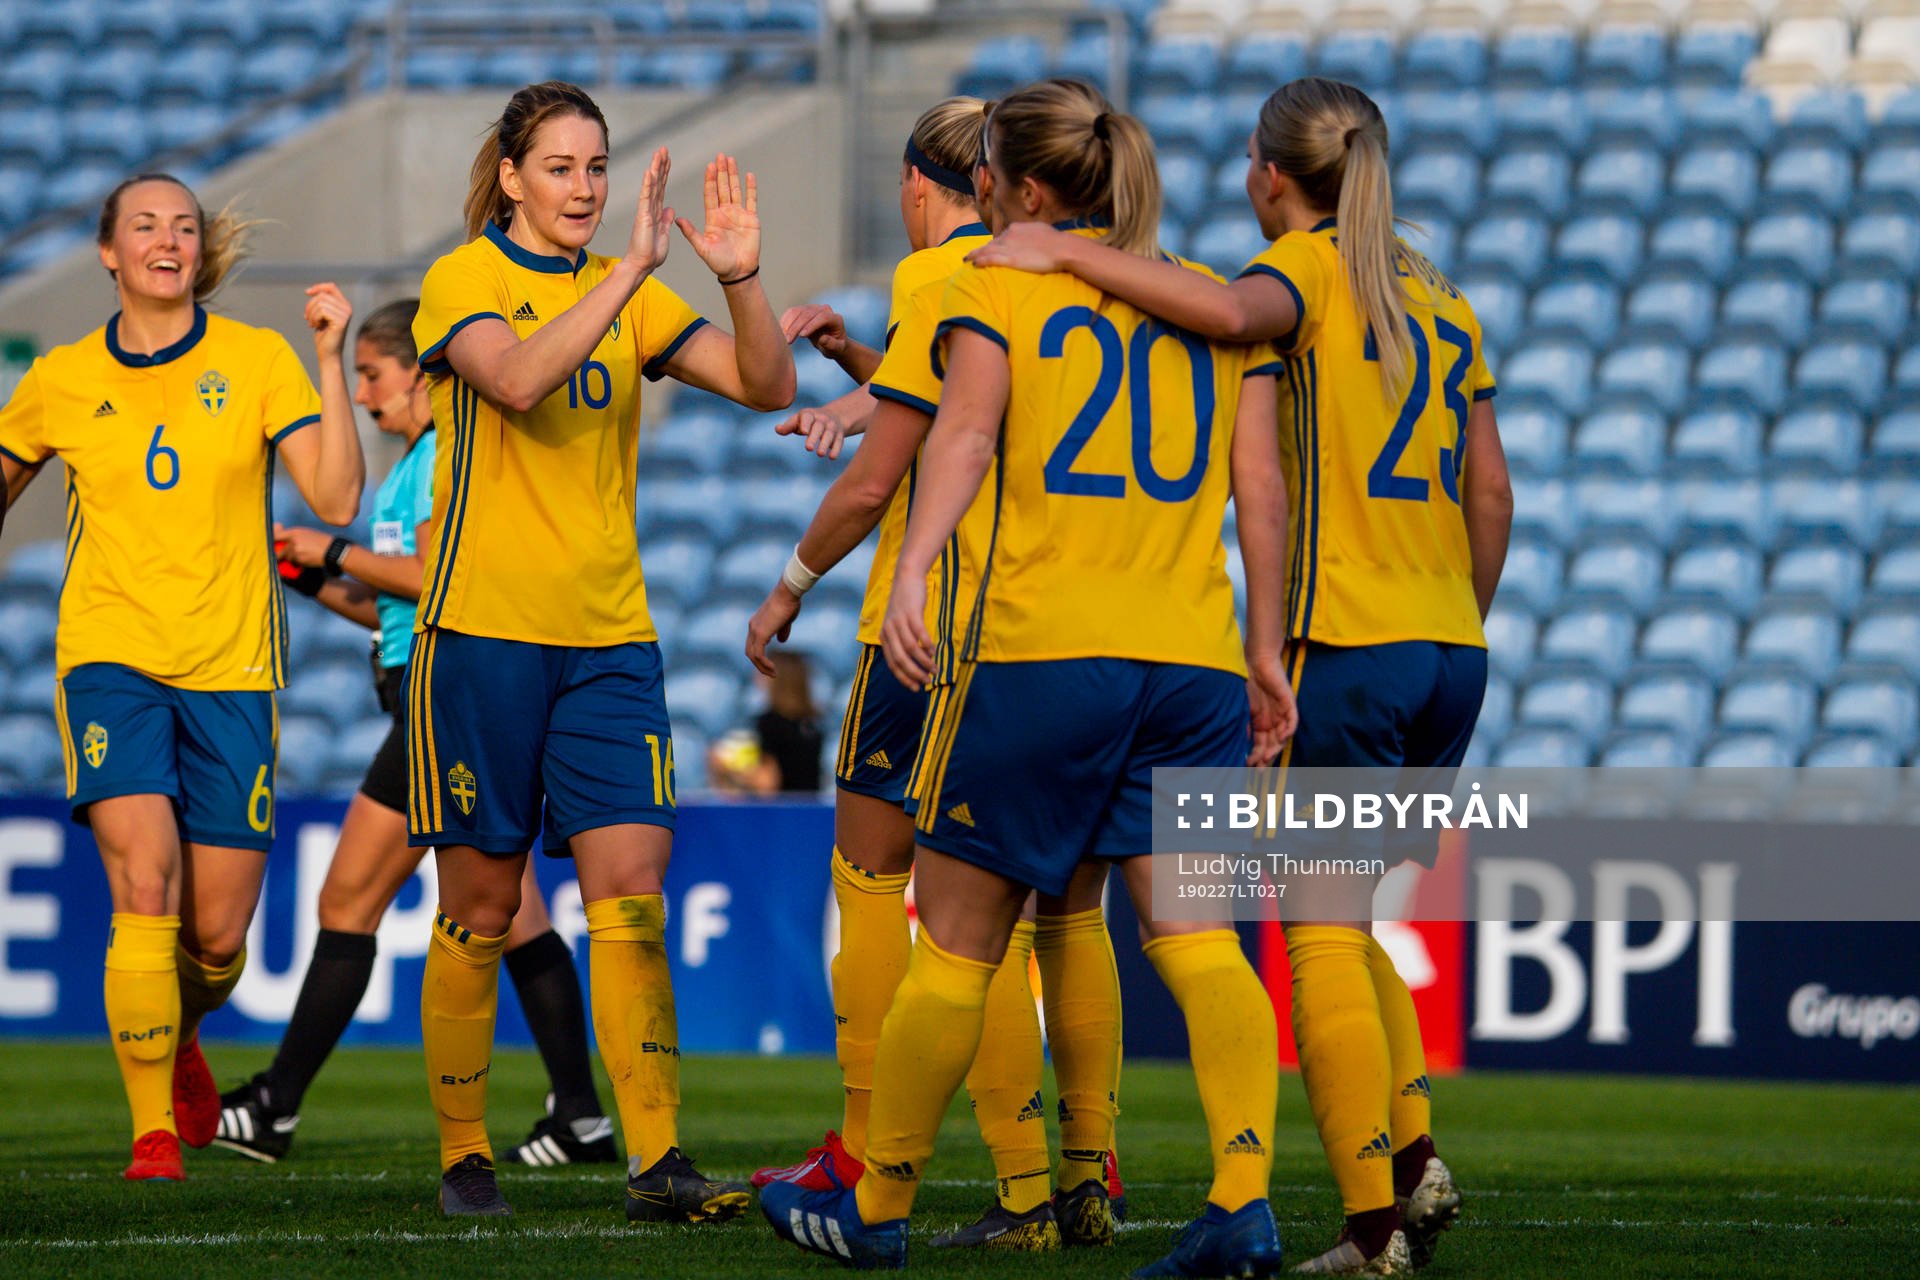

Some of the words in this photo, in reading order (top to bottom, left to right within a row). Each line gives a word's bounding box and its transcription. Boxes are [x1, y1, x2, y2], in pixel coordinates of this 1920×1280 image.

[512, 313, 538, 321] adidas
[1039, 305, 1216, 503] 20
[1364, 312, 1473, 506] 23
[146, 424, 180, 491] 6
[247, 764, 271, 832] 6
[1472, 857, 1740, 1047] BPI
[1788, 982, 1920, 1050] Grupo
[1223, 1144, 1265, 1156] adidas
